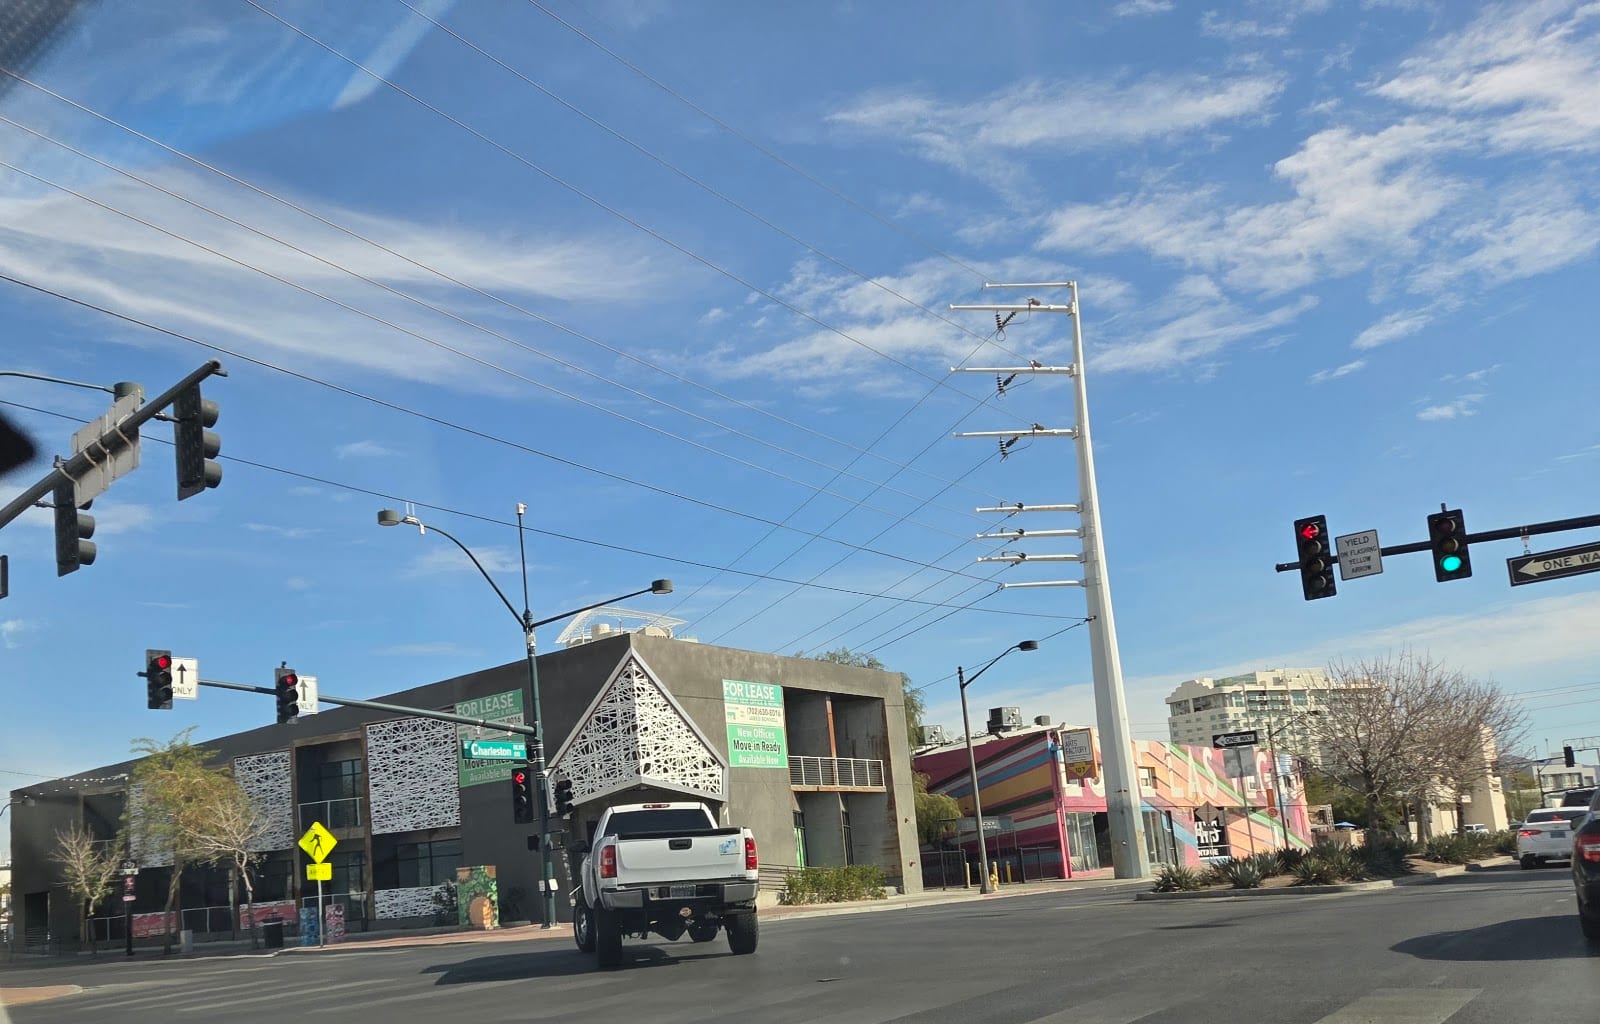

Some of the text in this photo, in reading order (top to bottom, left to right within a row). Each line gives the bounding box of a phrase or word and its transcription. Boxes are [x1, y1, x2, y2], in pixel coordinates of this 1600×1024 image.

[1344, 536, 1369, 546] YIELD
[1350, 545, 1376, 556] FLASHING
[1349, 556, 1371, 565] YELLOW
[1543, 553, 1600, 571] ONE WA
[1351, 565, 1371, 573] ARROW
[723, 681, 774, 699] FOR LEASE
[456, 693, 514, 717] FOR LEASE
[737, 727, 775, 739] New Offices
[1225, 735, 1239, 743] ONE
[471, 743, 513, 756] Charleston
[761, 740, 781, 754] Ready
[1065, 746, 1087, 754] FACTORY
[739, 754, 779, 765] Available Now
[502, 770, 513, 779] No
